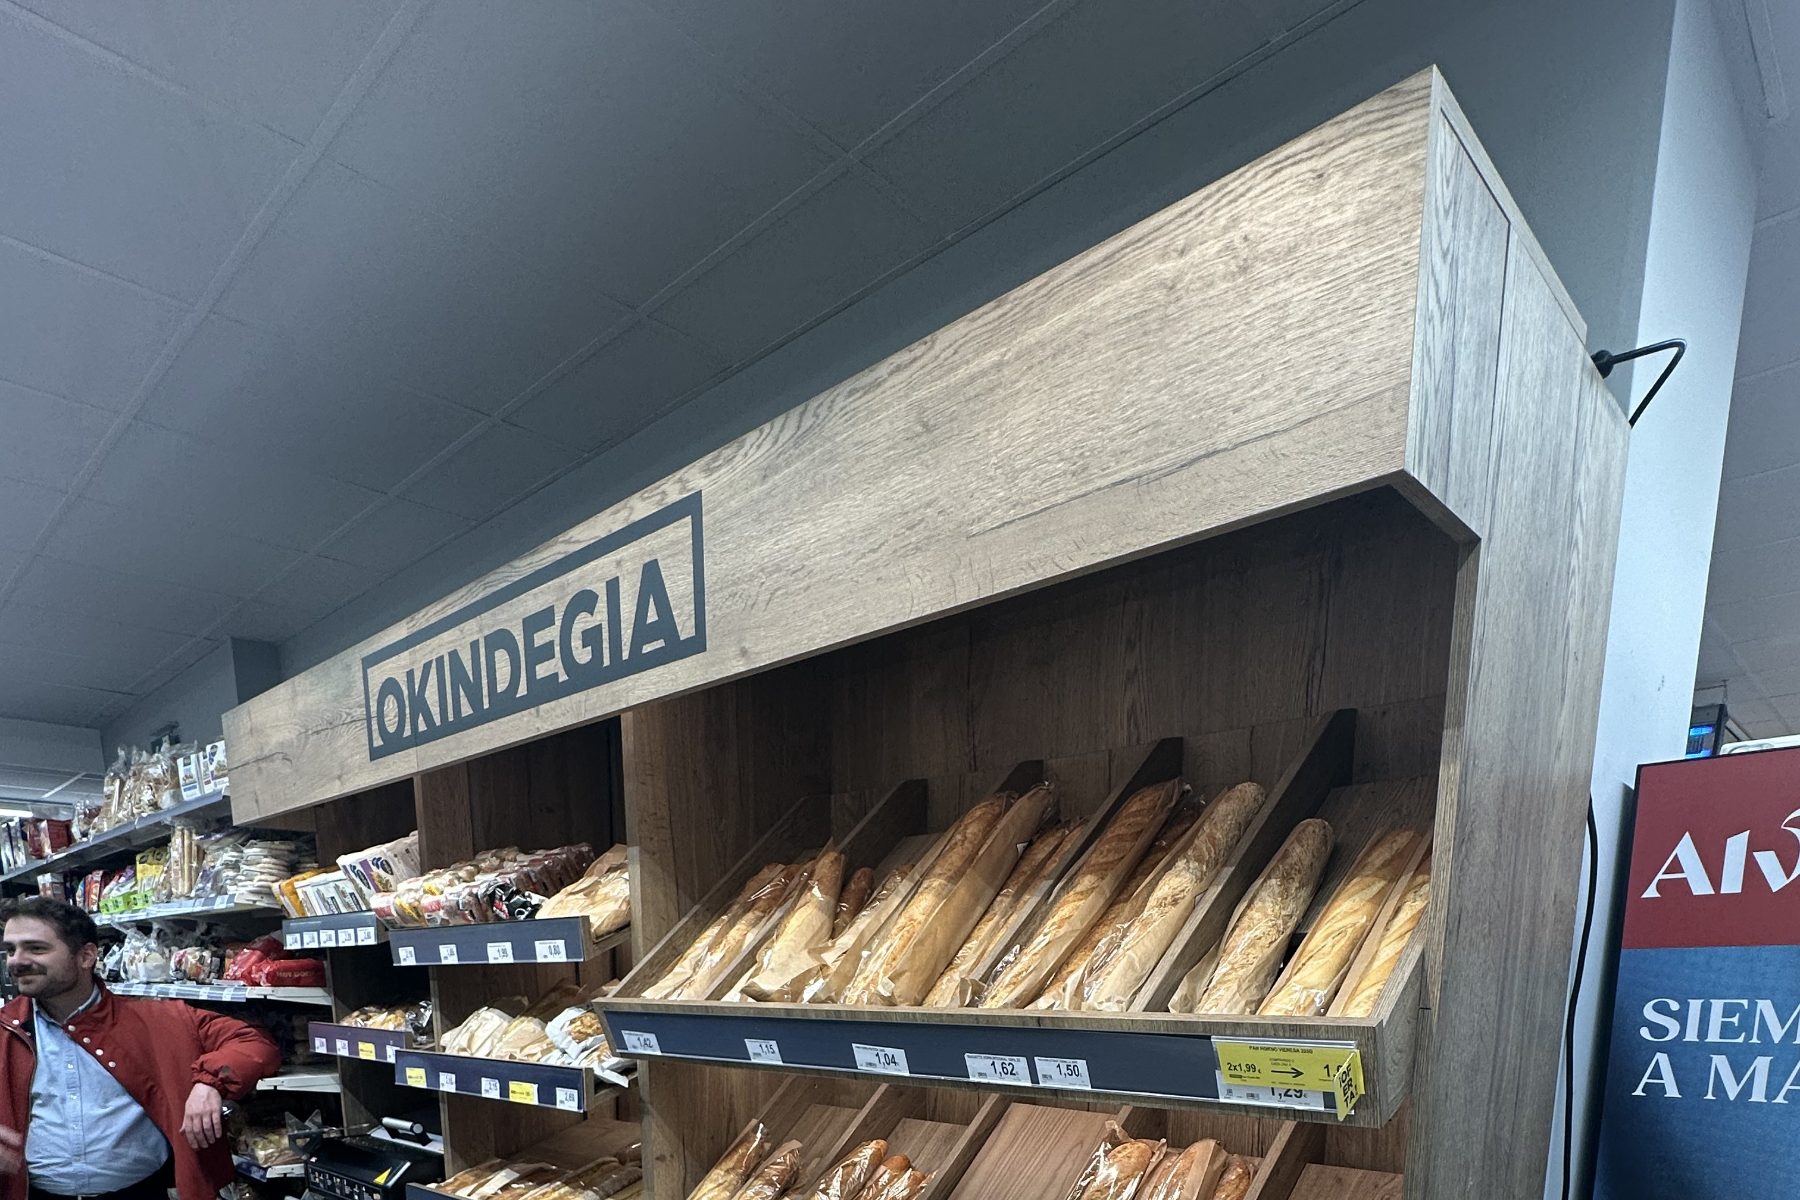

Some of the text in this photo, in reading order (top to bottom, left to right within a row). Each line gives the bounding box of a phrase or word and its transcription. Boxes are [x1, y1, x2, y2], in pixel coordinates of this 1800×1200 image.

[376, 558, 681, 744] OKINDEGIA
[1639, 998, 1800, 1044] SIEM
[759, 1043, 776, 1055] 1,15
[875, 1052, 897, 1068] 1,04
[990, 1060, 1017, 1077] 1,62
[1056, 1063, 1080, 1078] 1,50
[1631, 1052, 1682, 1099] A
